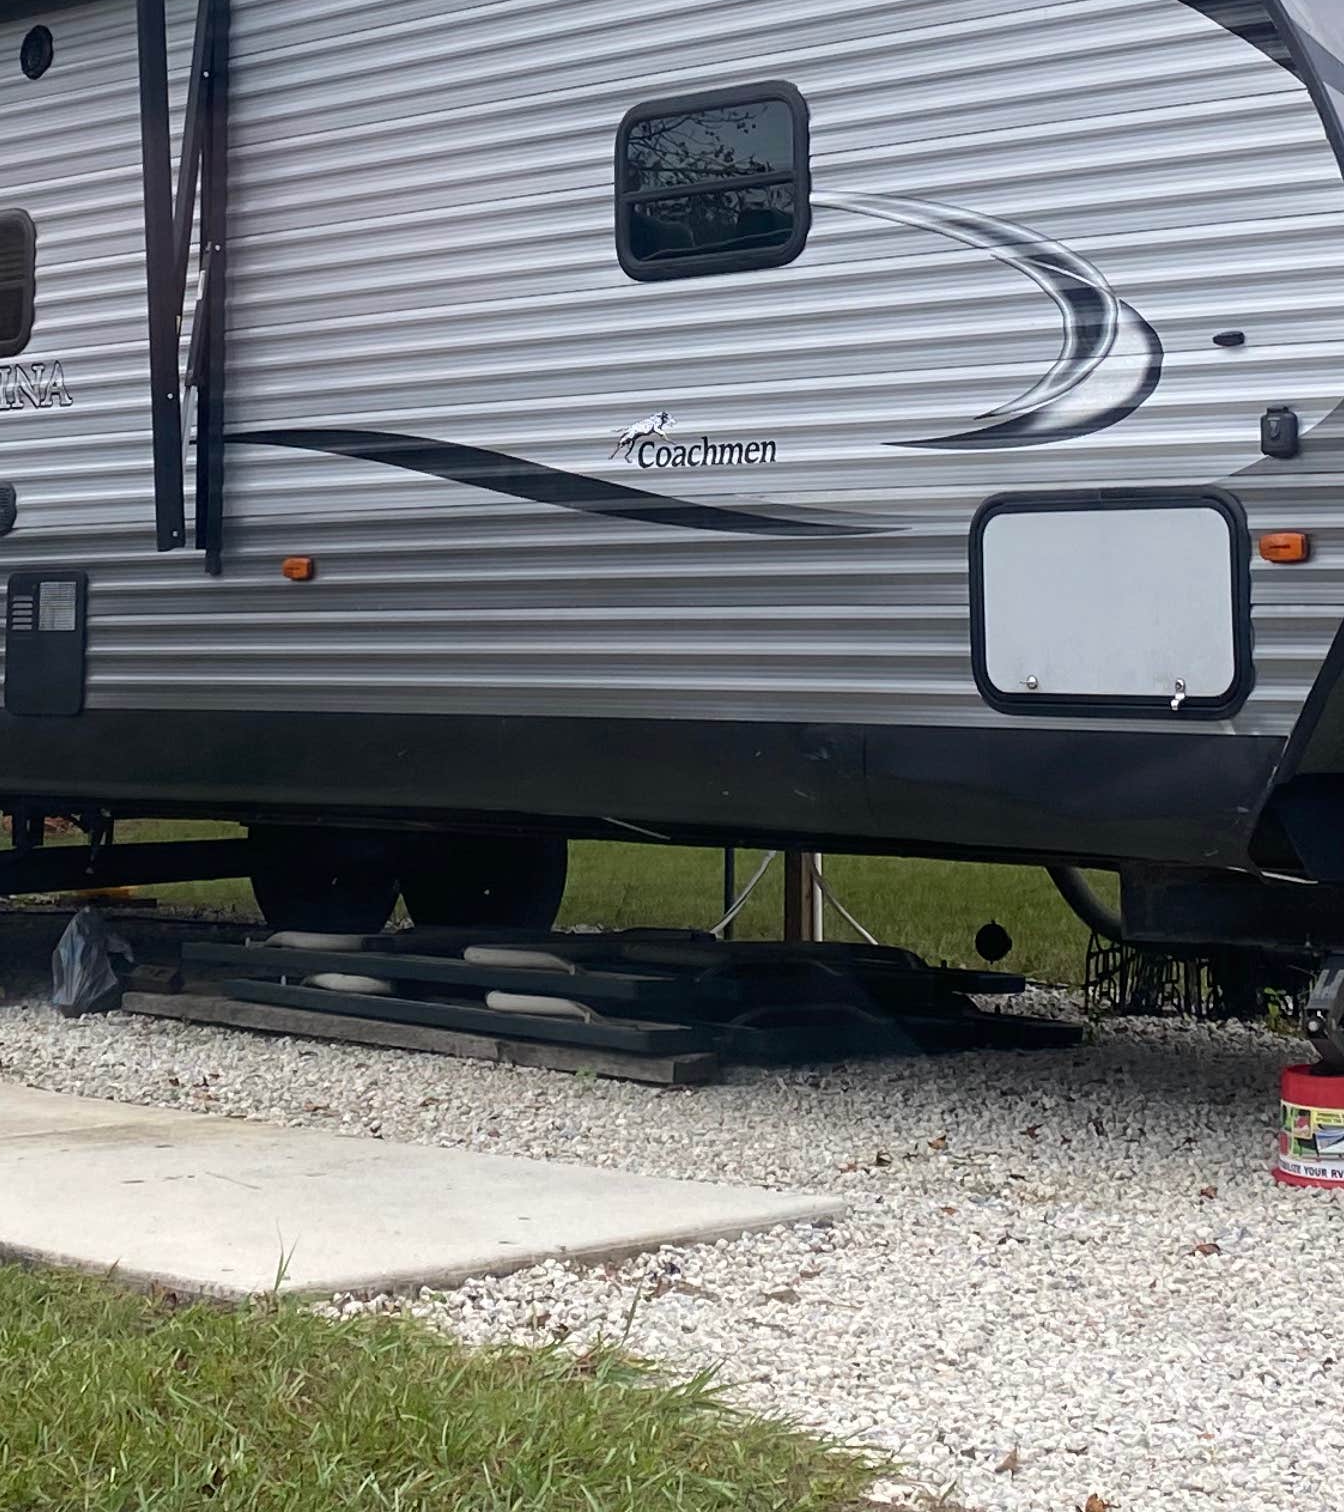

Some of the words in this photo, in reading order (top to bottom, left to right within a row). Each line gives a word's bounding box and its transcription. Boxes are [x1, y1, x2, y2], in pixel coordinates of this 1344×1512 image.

[638, 436, 777, 469] Coachmen
[1304, 1166, 1328, 1178] YOUR
[1331, 1169, 1344, 1179] RV
